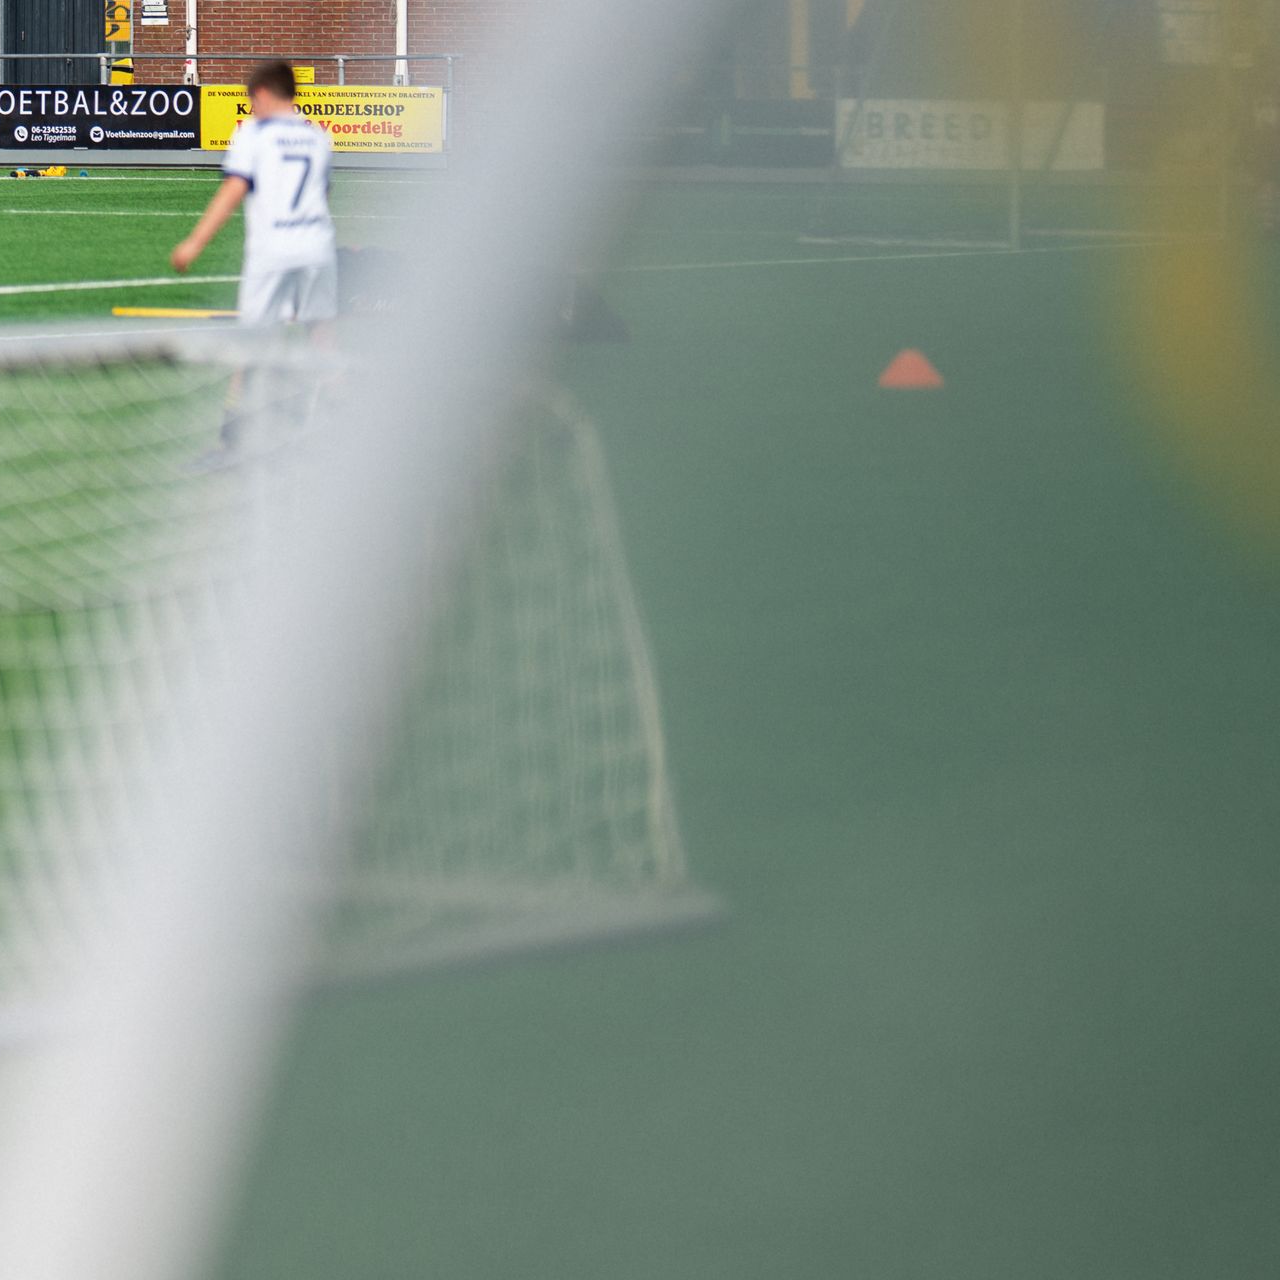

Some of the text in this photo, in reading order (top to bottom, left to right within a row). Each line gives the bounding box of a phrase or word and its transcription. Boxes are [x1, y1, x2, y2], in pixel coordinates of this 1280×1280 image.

[292, 103, 405, 116] OORDEELSHOP
[31, 126, 77, 134] 06-23452536
[105, 129, 195, 140] Voetbalenzoo@gmail.com
[319, 119, 403, 138] Voordelig
[31, 133, 77, 143] Leo Tiggelman
[282, 153, 312, 211] 7
